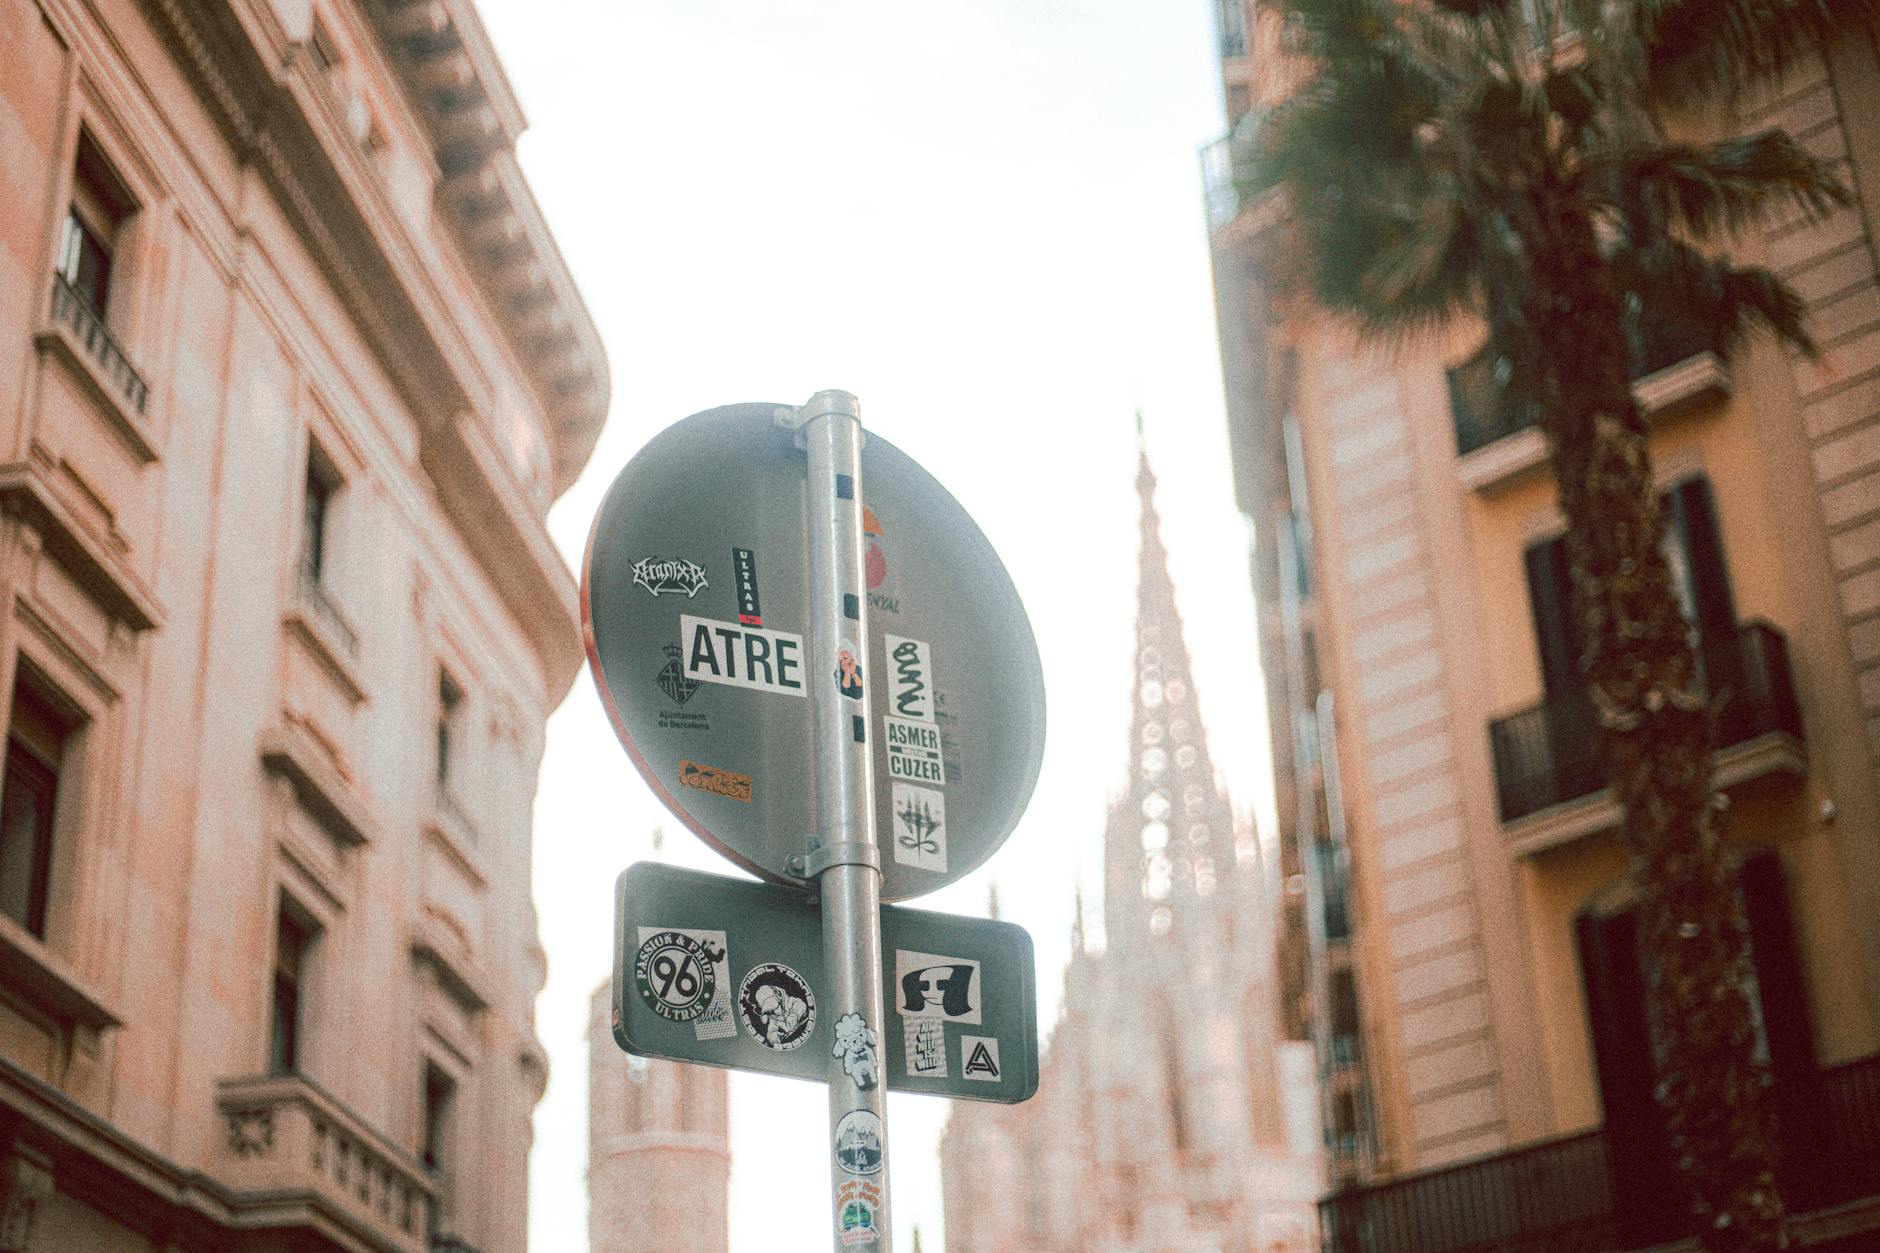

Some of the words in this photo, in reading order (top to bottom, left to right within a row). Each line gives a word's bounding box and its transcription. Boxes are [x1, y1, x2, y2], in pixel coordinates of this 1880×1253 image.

[739, 551, 754, 611] ULTRAS
[689, 624, 801, 689] ATRE
[658, 720, 668, 728] de
[670, 720, 710, 729] Barcelona
[659, 711, 706, 721] Ajuntament
[889, 723, 938, 749] ASMER
[891, 755, 941, 781] CUZER
[637, 934, 673, 979] PASSION
[676, 936, 685, 946] &
[688, 943, 714, 983] PRIDE
[653, 955, 698, 1000] 96
[655, 1003, 704, 1021] ULTRAS
